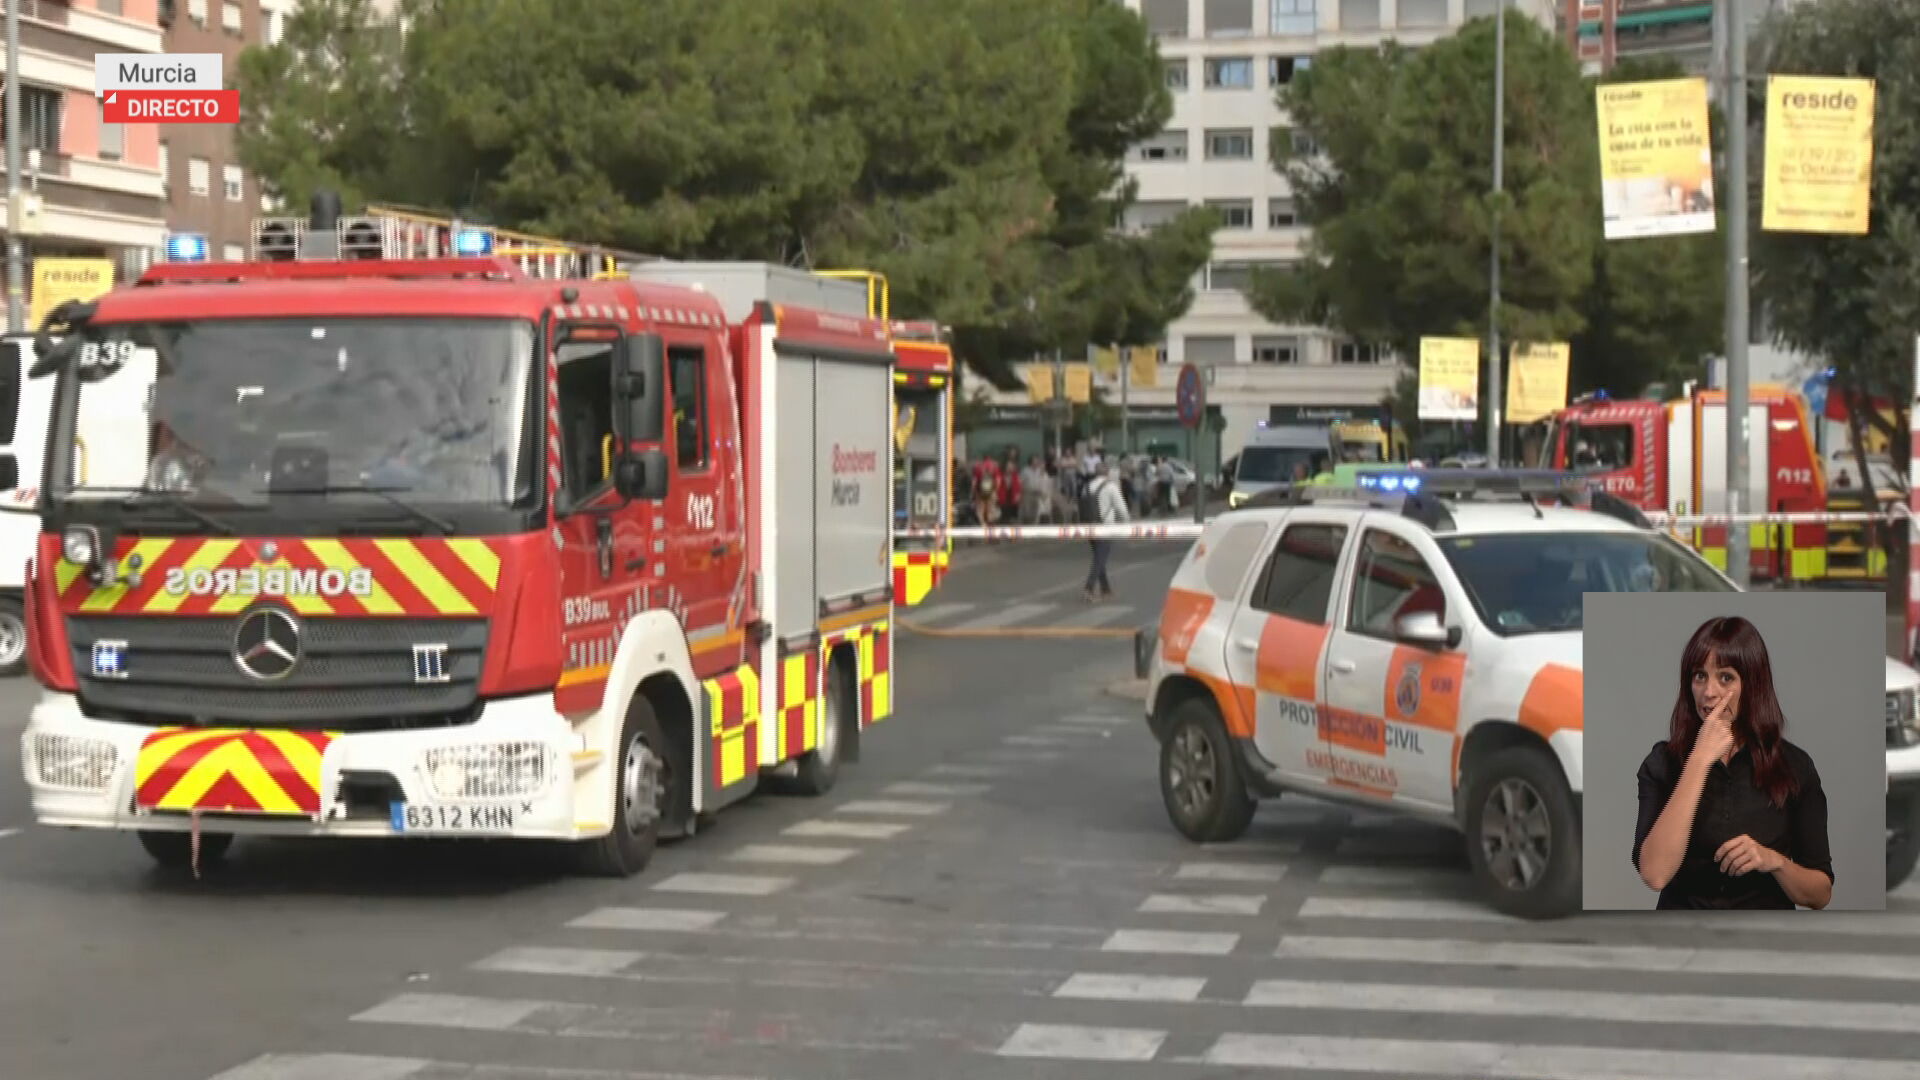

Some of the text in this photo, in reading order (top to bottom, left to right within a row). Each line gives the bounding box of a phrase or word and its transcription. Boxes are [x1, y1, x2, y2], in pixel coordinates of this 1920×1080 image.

[1782, 90, 1857, 110] reside
[43, 268, 99, 282] reside
[80, 341, 136, 366] B39
[832, 443, 877, 474] Bomberos
[831, 479, 860, 506] Murcia
[1606, 476, 1635, 492] E70
[692, 495, 714, 530] 112
[1384, 725, 1424, 755] CIVIL
[1305, 748, 1398, 787] EMERGENCIAS
[470, 805, 512, 828] KHN
